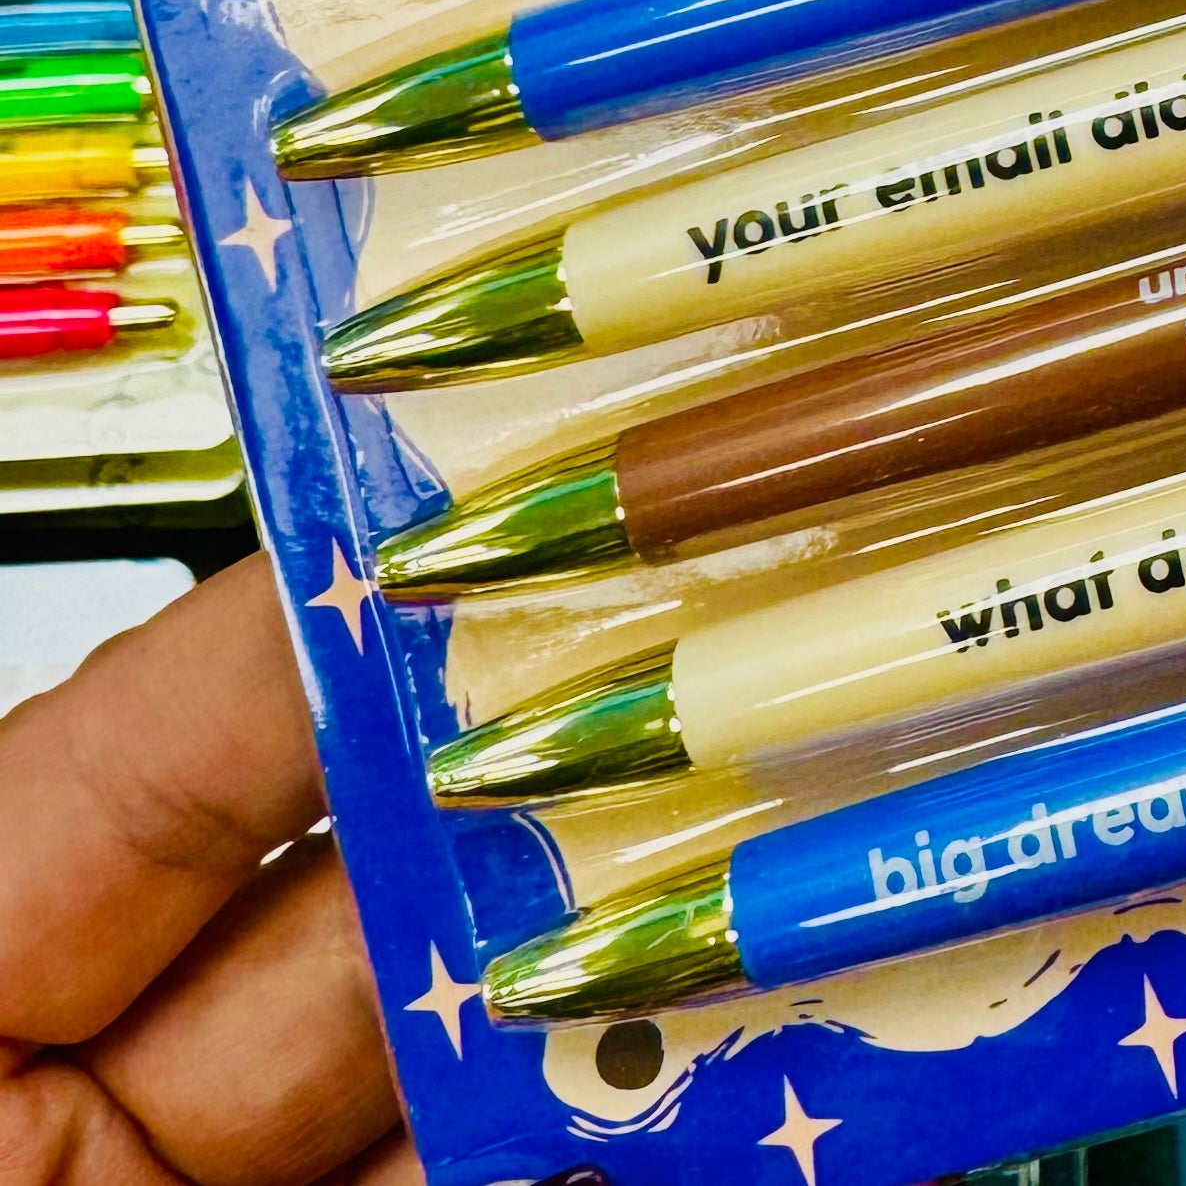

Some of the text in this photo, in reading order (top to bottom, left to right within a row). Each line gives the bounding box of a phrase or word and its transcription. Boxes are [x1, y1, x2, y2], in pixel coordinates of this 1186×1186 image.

[687, 184, 849, 283] your
[874, 109, 1073, 214] email
[937, 549, 1116, 654] what
[869, 837, 987, 906] big
